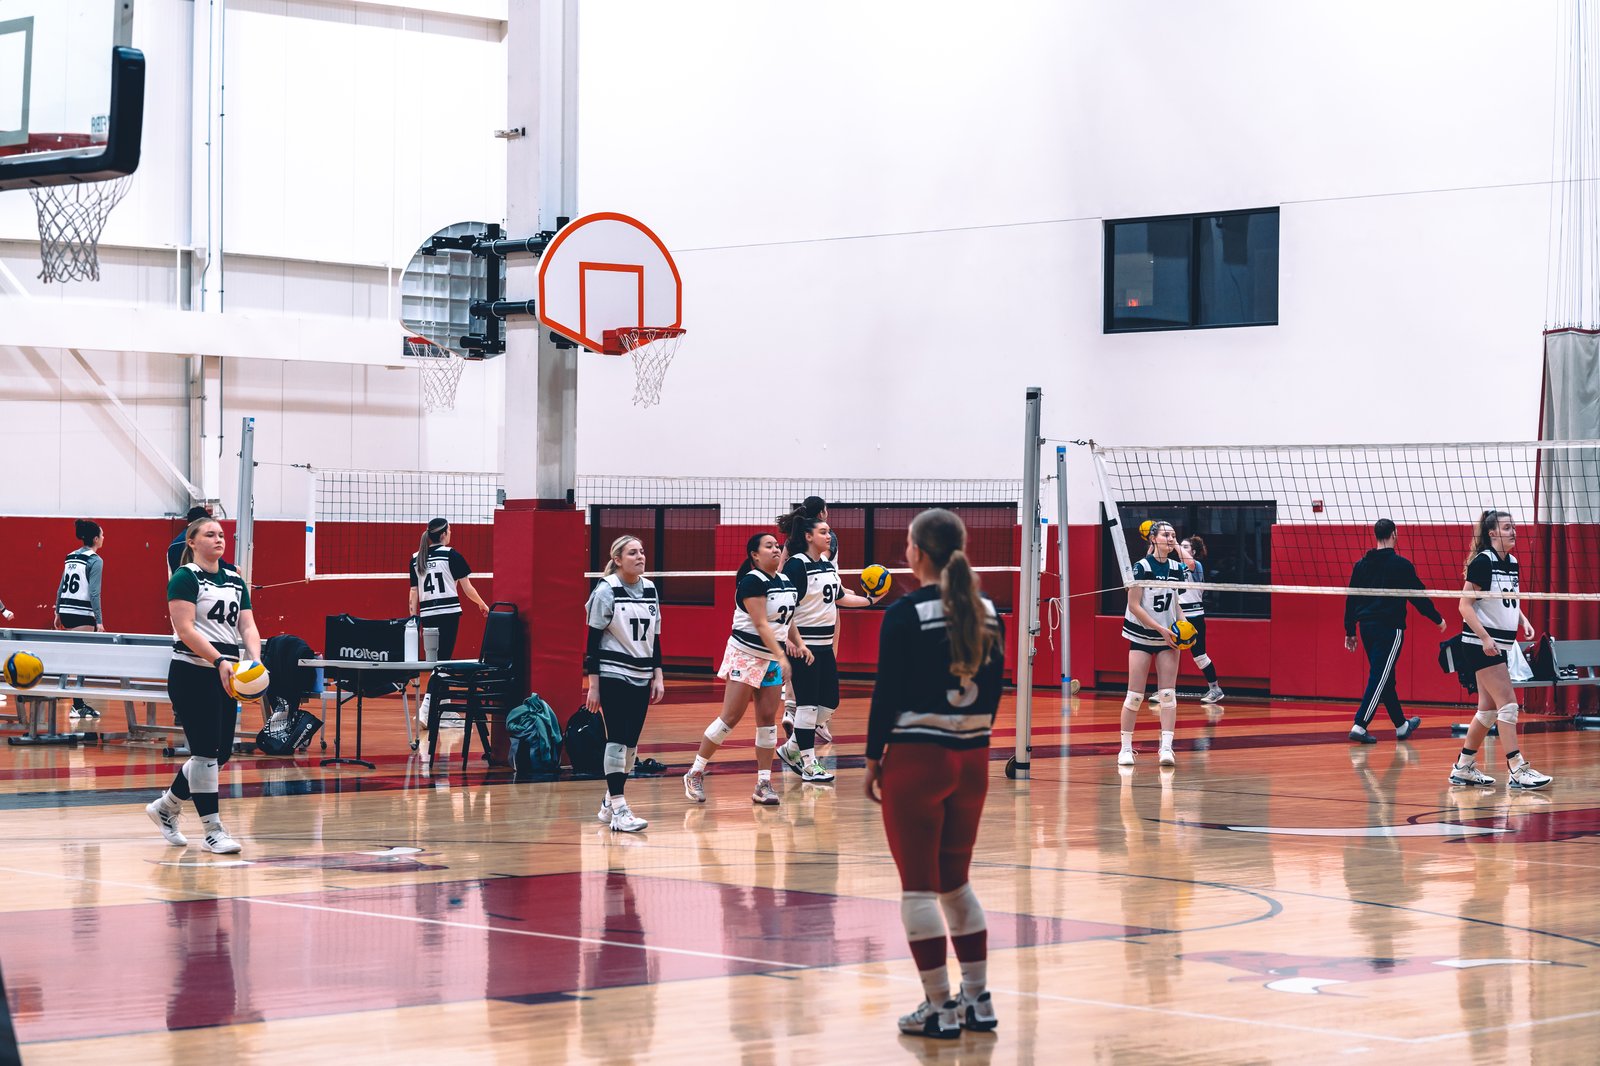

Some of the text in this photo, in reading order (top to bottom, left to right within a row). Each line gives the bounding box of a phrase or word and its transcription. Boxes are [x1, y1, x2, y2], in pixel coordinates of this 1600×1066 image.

[423, 572, 446, 594] 41
[822, 583, 838, 603] 97
[207, 599, 239, 627] 48
[629, 617, 651, 641] 17
[340, 646, 388, 662] molten
